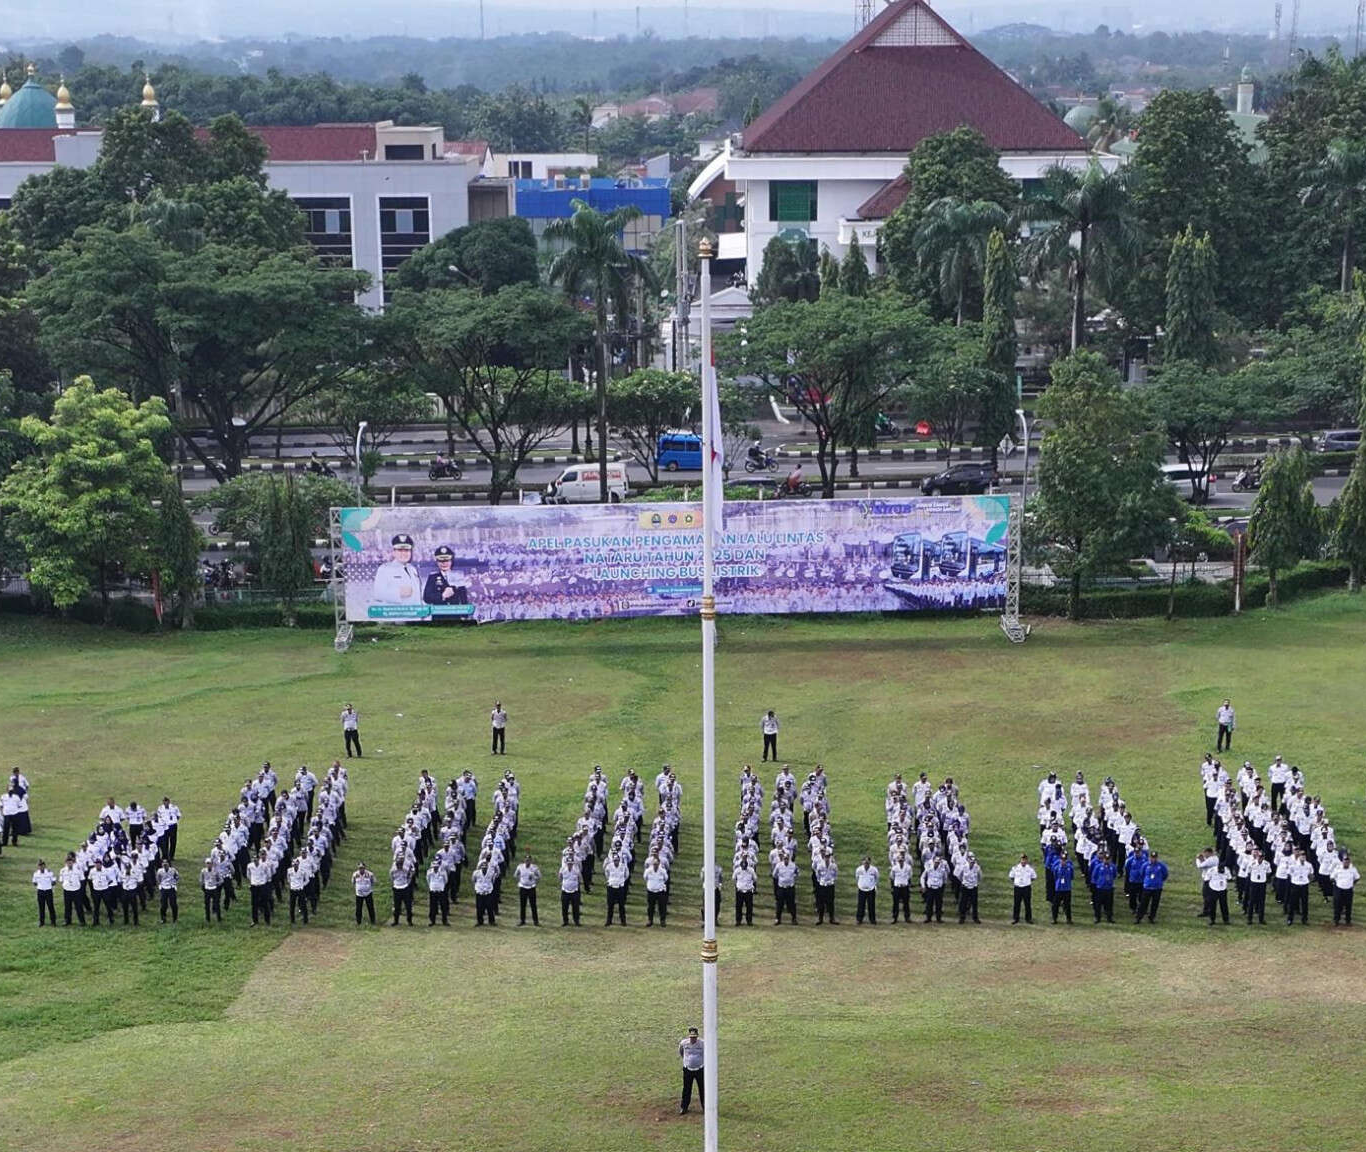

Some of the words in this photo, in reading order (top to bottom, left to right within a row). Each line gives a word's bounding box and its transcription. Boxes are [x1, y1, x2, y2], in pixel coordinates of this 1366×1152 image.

[528, 538, 559, 548] APEL
[565, 536, 631, 548] PASUKAN
[636, 535, 735, 546] PENGAMAN
[740, 534, 772, 544] LALU
[777, 532, 824, 542] LINTAS
[586, 553, 642, 564] NATARU
[648, 552, 694, 562] TAHUN
[698, 550, 731, 560] 225
[736, 550, 765, 560] DAN
[594, 568, 675, 579] LAUNCHING
[680, 567, 704, 577] BUS
